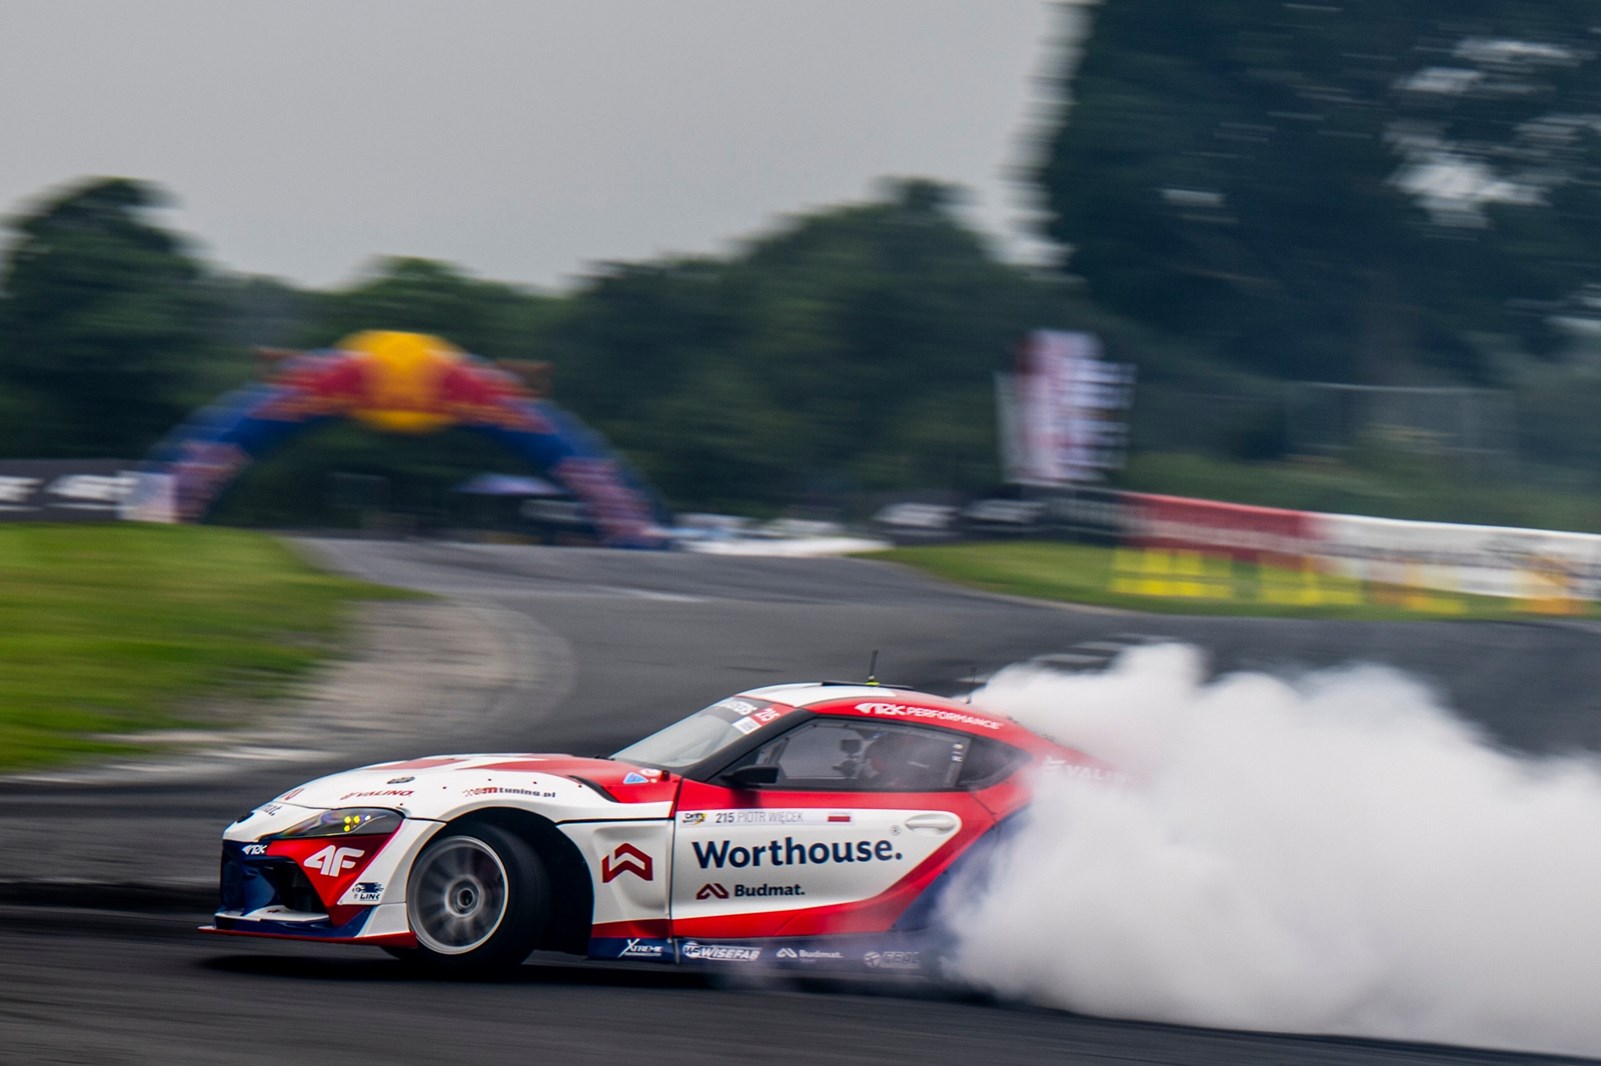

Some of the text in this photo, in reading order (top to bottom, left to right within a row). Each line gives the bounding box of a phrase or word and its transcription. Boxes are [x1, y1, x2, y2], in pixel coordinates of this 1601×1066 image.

[907, 706, 1004, 730] PERFORMANCE
[715, 812, 735, 824] 215
[737, 811, 767, 823] PIOTR
[303, 844, 365, 878] 4F
[692, 836, 903, 869] Worthouse.
[734, 882, 805, 897] Budmat.
